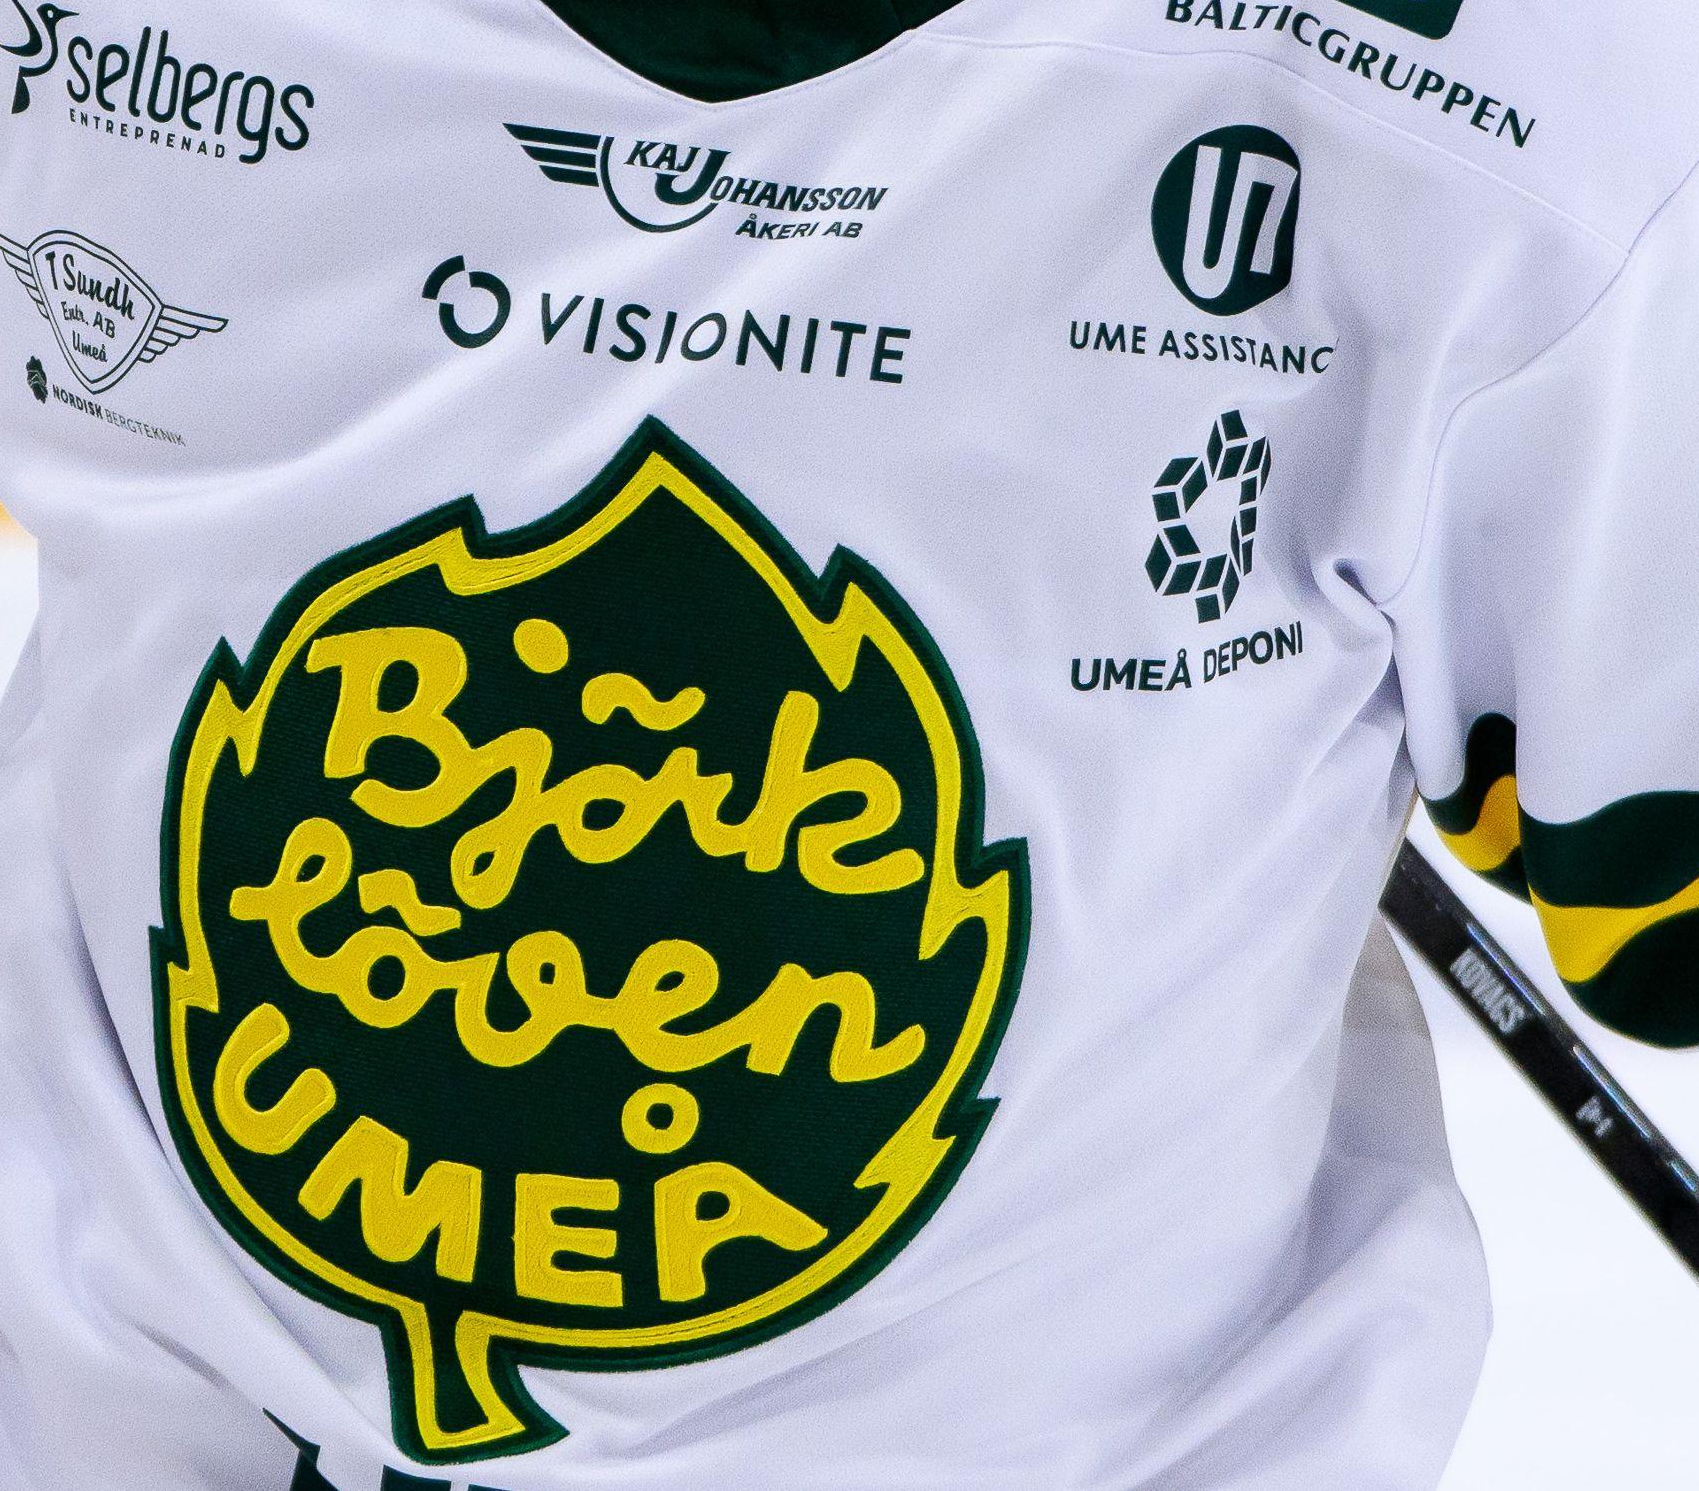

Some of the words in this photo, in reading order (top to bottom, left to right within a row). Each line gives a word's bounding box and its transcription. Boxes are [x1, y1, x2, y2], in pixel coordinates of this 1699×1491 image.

[69, 107, 227, 160] ENTREPRENAD
[623, 139, 702, 173] KAJ
[734, 213, 820, 241] ÅKERI
[821, 220, 864, 240] AB
[62, 253, 135, 321] Sundh
[92, 310, 116, 339] AB
[541, 292, 912, 385] VISIONITE
[1069, 319, 1147, 355] UME
[1158, 328, 1340, 375] ASSISTANC
[52, 383, 104, 421] NORDISK
[104, 408, 187, 447] BERGTEKNIK
[1070, 647, 1192, 692] UMEÅ
[1203, 620, 1303, 684] DEPONI
[213, 1001, 829, 1307] UMEÅ
